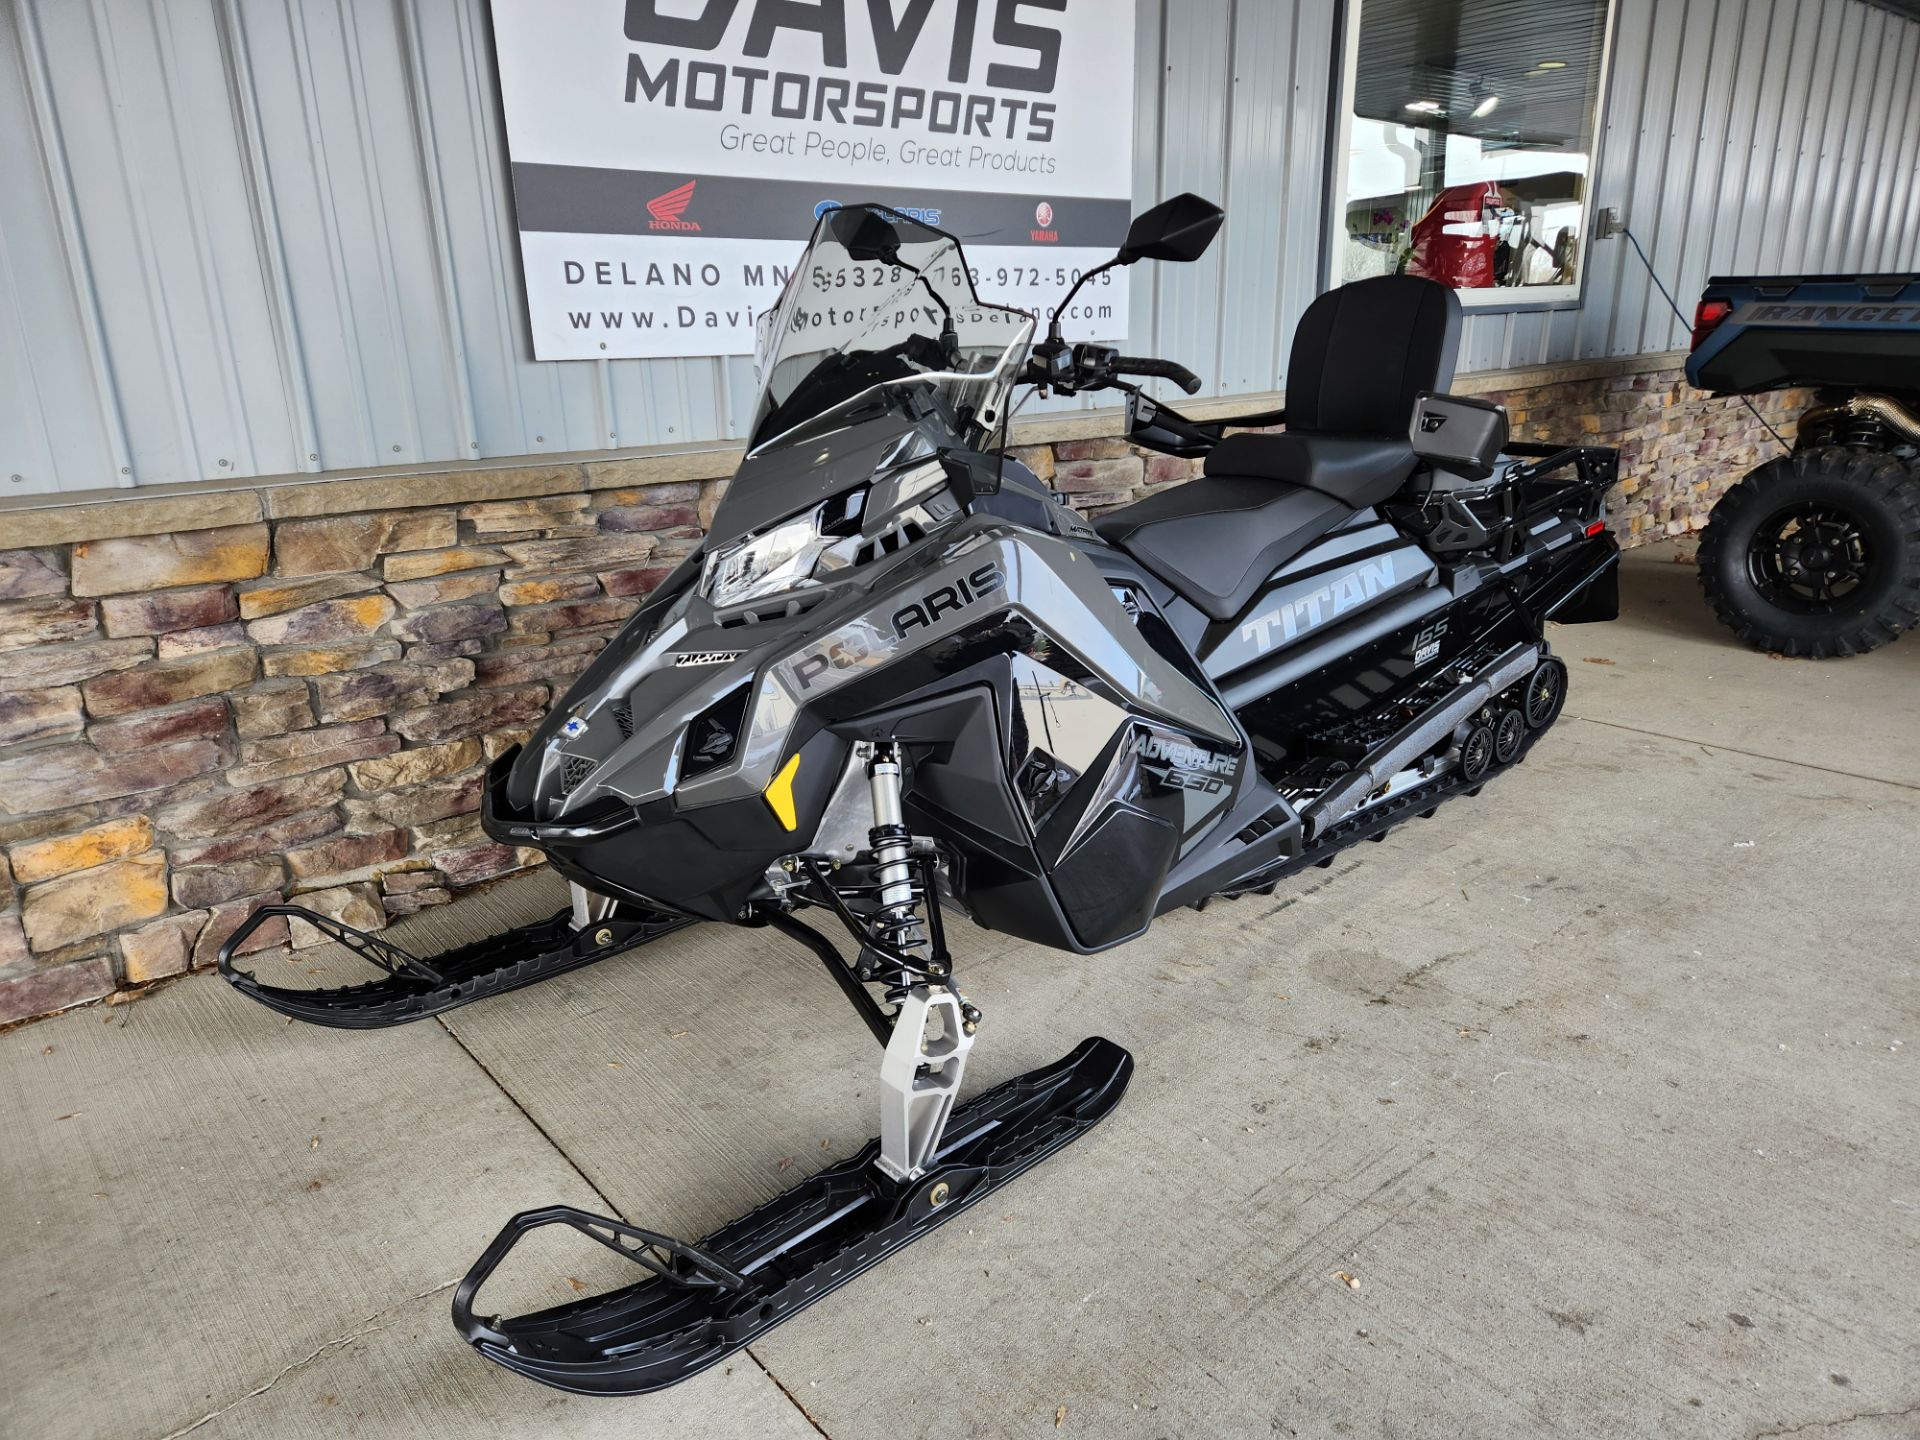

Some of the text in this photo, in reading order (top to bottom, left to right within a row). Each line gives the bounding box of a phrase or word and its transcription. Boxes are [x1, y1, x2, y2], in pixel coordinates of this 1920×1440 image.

[624, 53, 1056, 142] MOTORSPORTS
[720, 124, 1056, 174] Great People, Great Products
[648, 220, 702, 231] HONDA
[1030, 229, 1058, 242] YAMAHA
[564, 261, 720, 286] DELANO
[743, 265, 789, 286] MN
[1241, 553, 1396, 653] TITAN
[792, 560, 1006, 690] POLARIS
[1411, 616, 1450, 652] 155
[1137, 733, 1239, 776] ADVENTURE
[1160, 768, 1225, 795] 650
